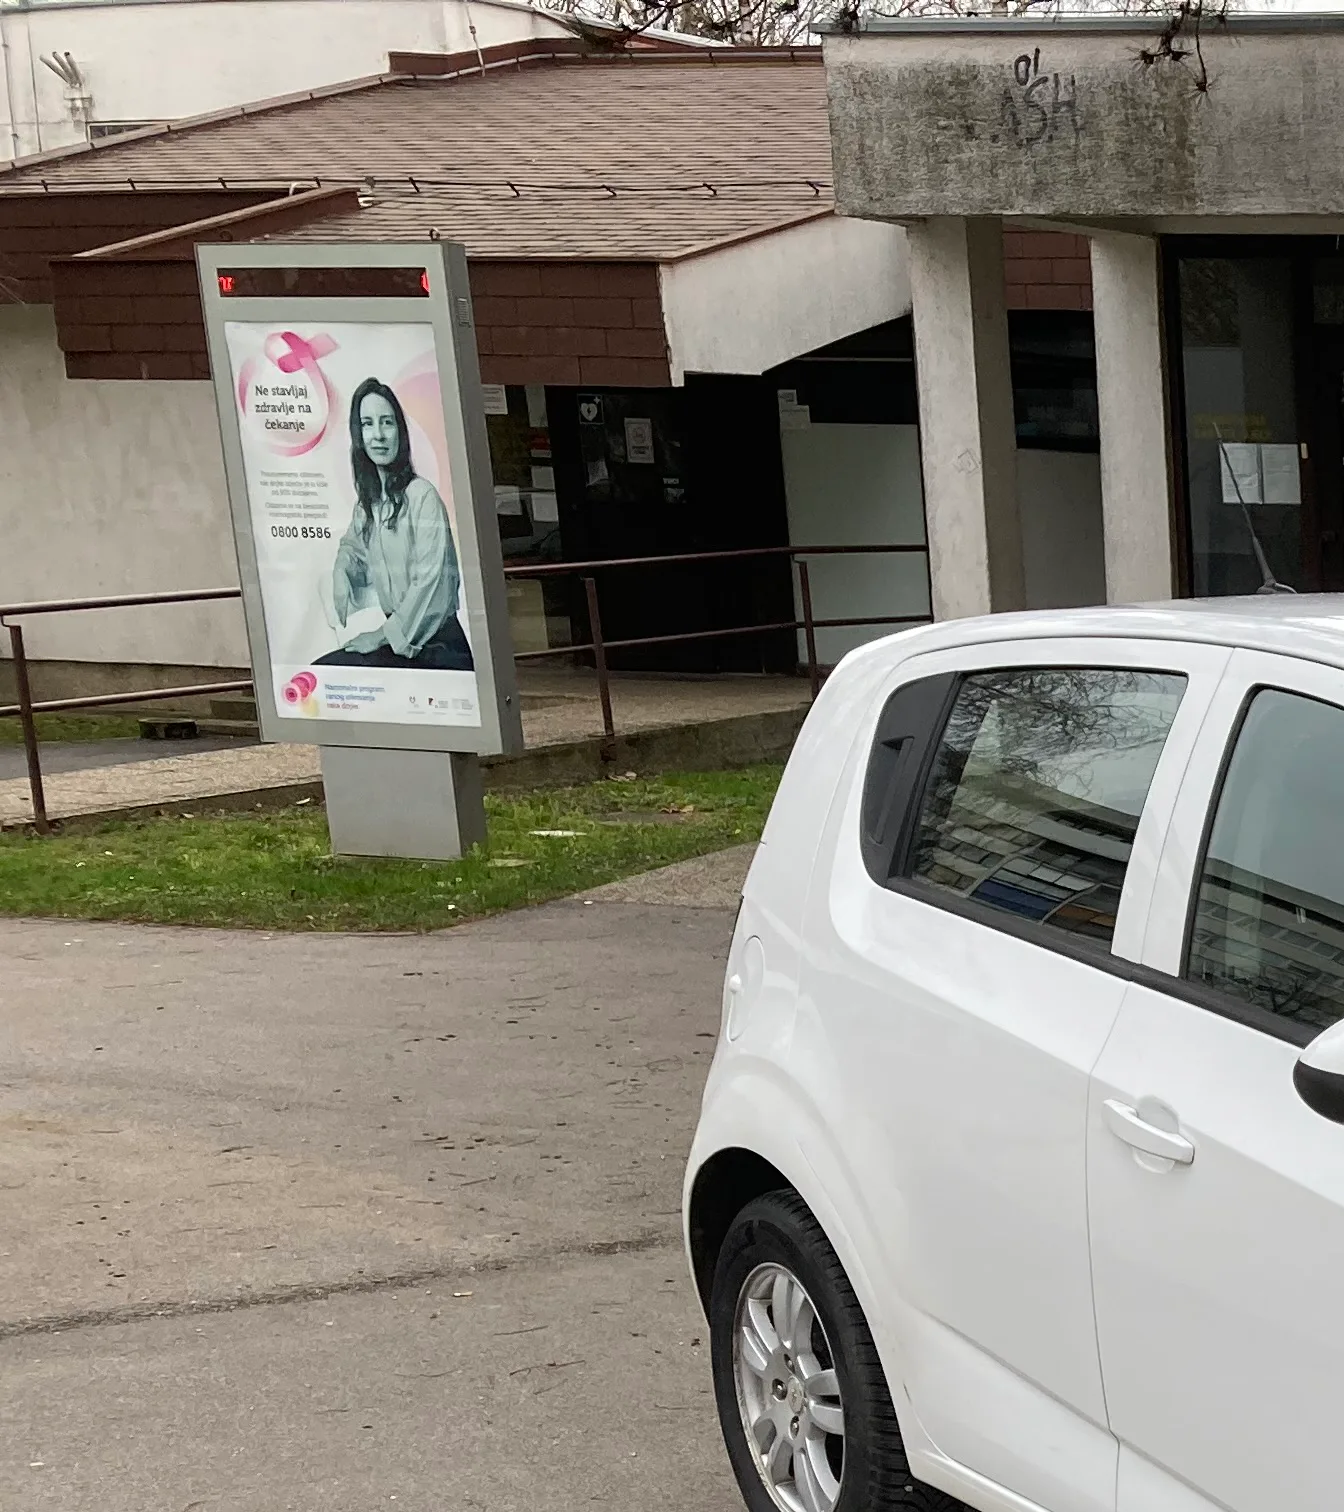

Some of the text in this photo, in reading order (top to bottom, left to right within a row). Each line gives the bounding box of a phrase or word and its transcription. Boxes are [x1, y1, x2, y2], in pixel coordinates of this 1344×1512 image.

[255, 384, 308, 399] Ne stavljaj
[255, 402, 312, 415] zdravlje na
[264, 418, 305, 432] čekanje
[271, 525, 331, 539] 0800 8586
